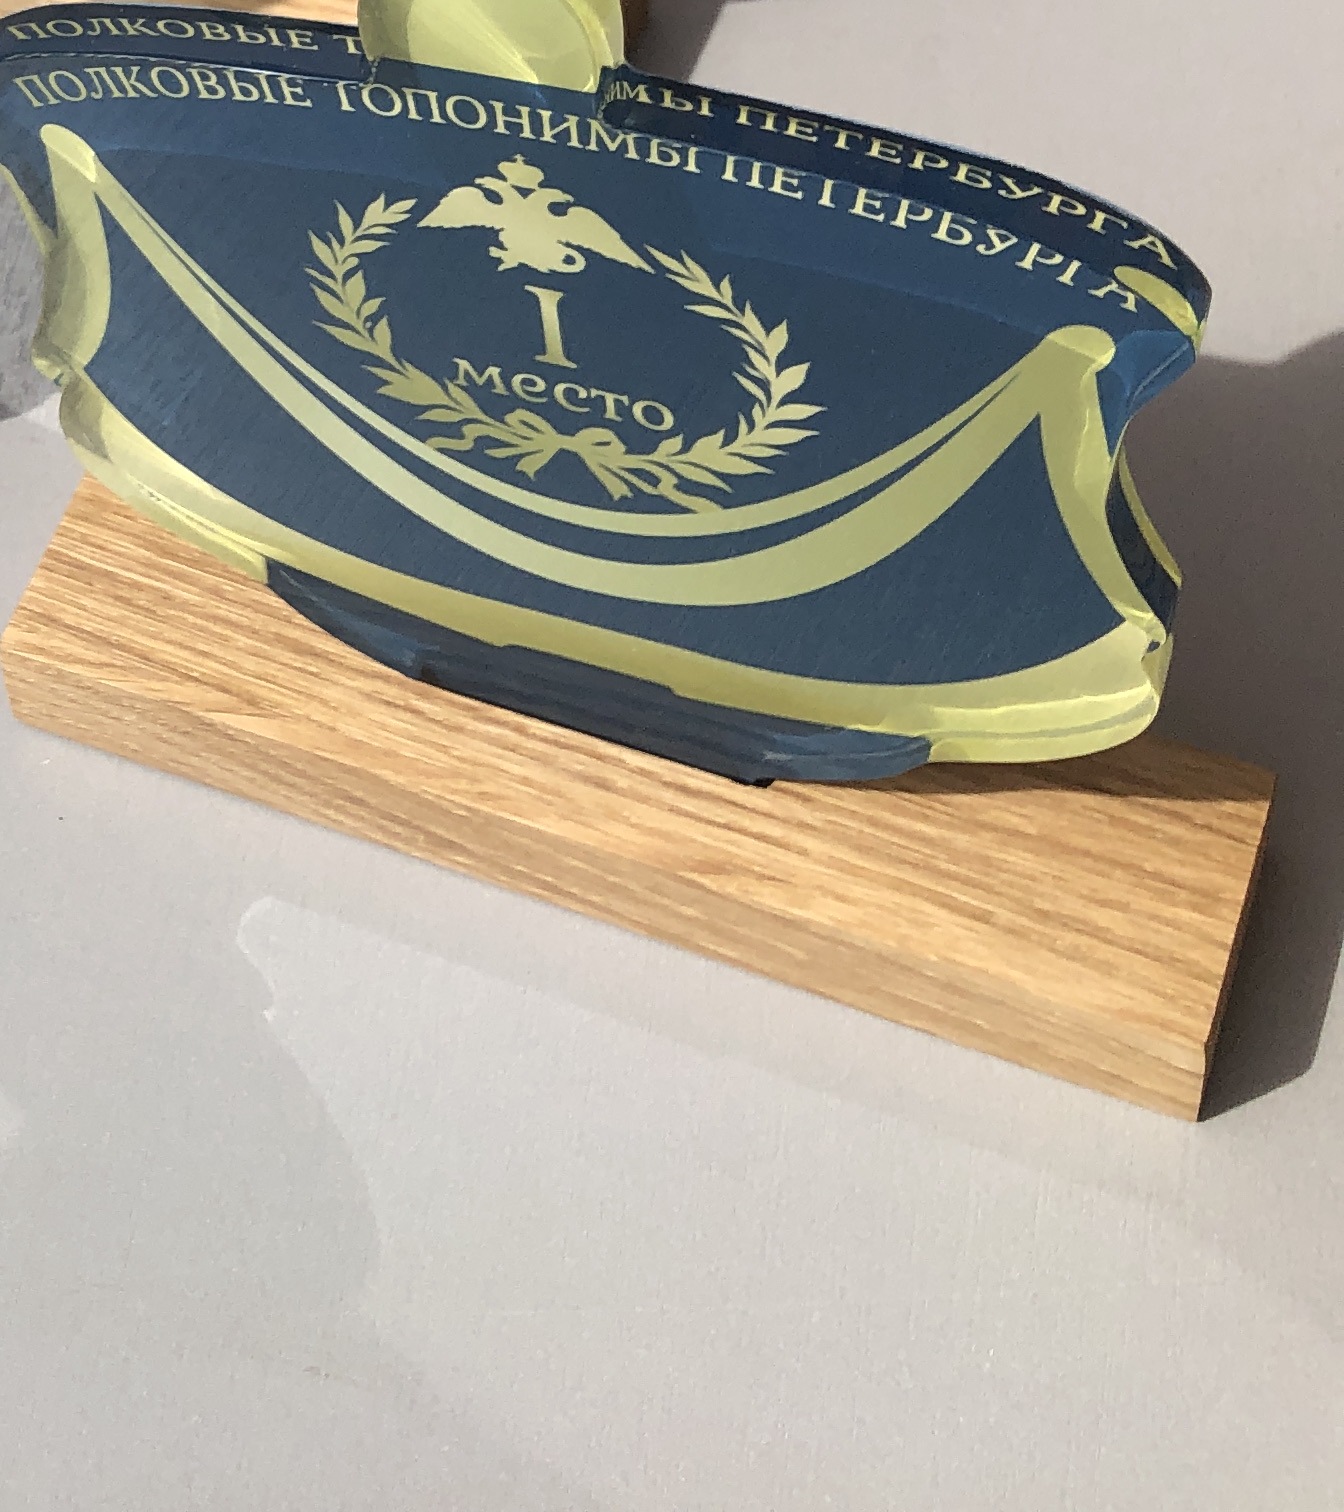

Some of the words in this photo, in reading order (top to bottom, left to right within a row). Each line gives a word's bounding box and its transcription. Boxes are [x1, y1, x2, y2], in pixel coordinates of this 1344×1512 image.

[7, 17, 319, 51] ПОЛКОВЫЕ
[735, 104, 1179, 269] ПЕТЕРБУРГА
[13, 65, 313, 109] ПОЛКОВЫЕ
[334, 80, 702, 174] ТОПОНИМЫ
[524, 285, 578, 369] I
